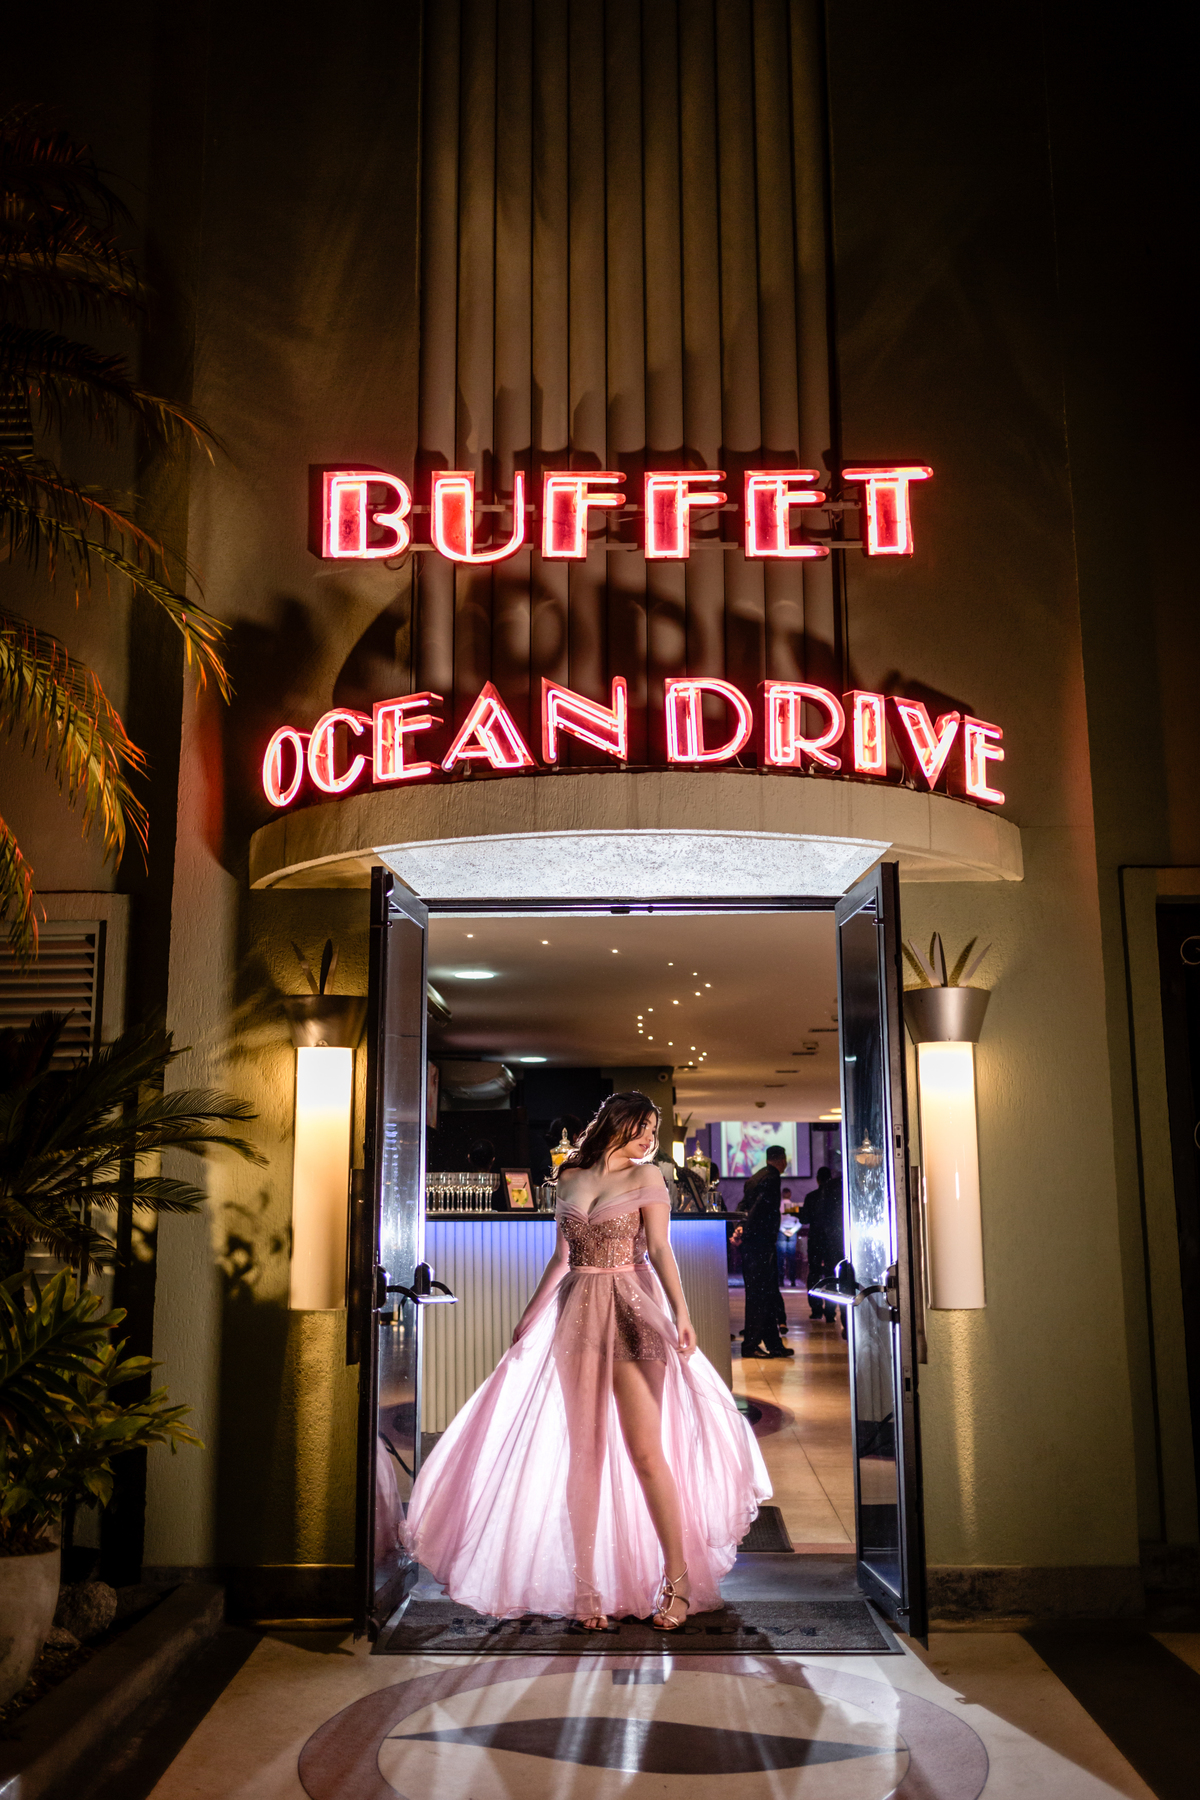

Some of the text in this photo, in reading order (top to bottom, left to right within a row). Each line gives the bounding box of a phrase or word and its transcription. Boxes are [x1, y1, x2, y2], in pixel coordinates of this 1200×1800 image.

[322, 466, 934, 563] BUFFET
[262, 676, 1006, 808] OCEAN DRIVE
